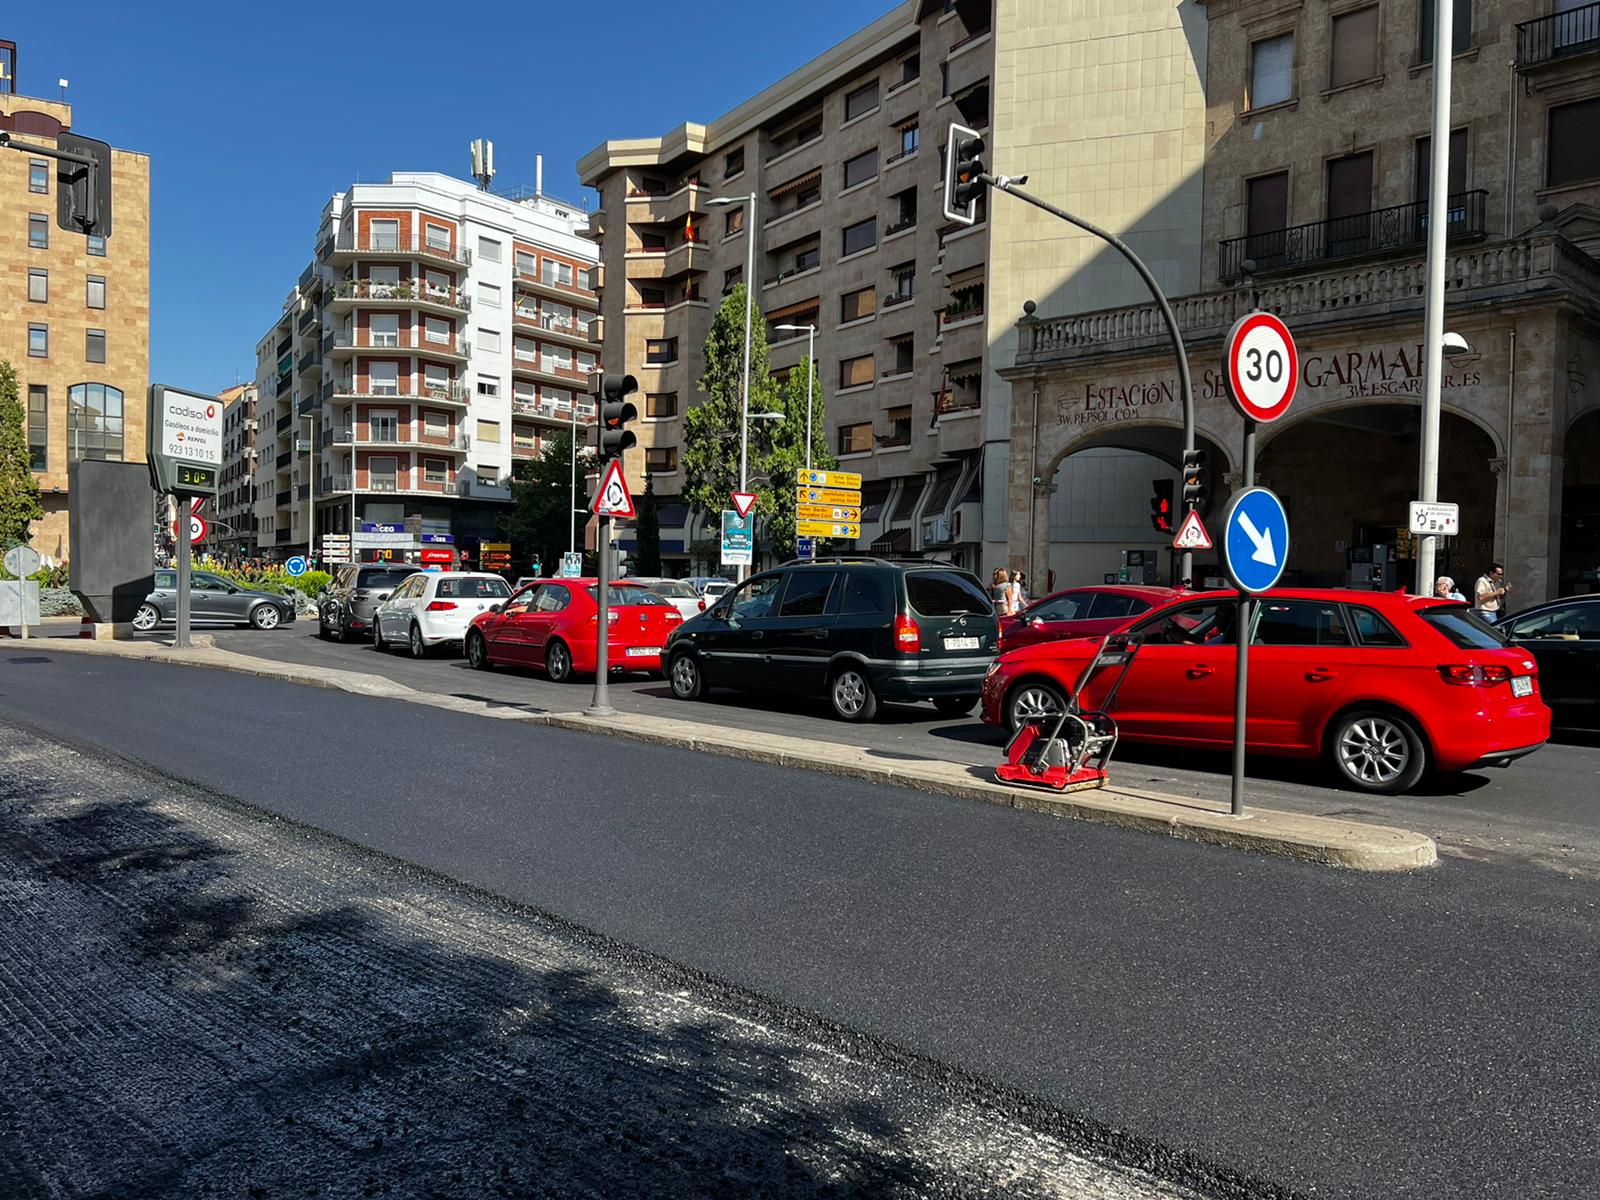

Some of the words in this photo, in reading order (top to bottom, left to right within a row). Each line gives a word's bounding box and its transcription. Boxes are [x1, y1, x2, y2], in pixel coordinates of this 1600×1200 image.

[1246, 347, 1283, 383] 30
[1346, 372, 1481, 398] 3W.ESGARR.ES
[195, 425, 219, 437] domicilio
[168, 443, 183, 455] 923
[184, 446, 193, 457] 13
[195, 447, 204, 458] 10
[205, 449, 215, 460] 15
